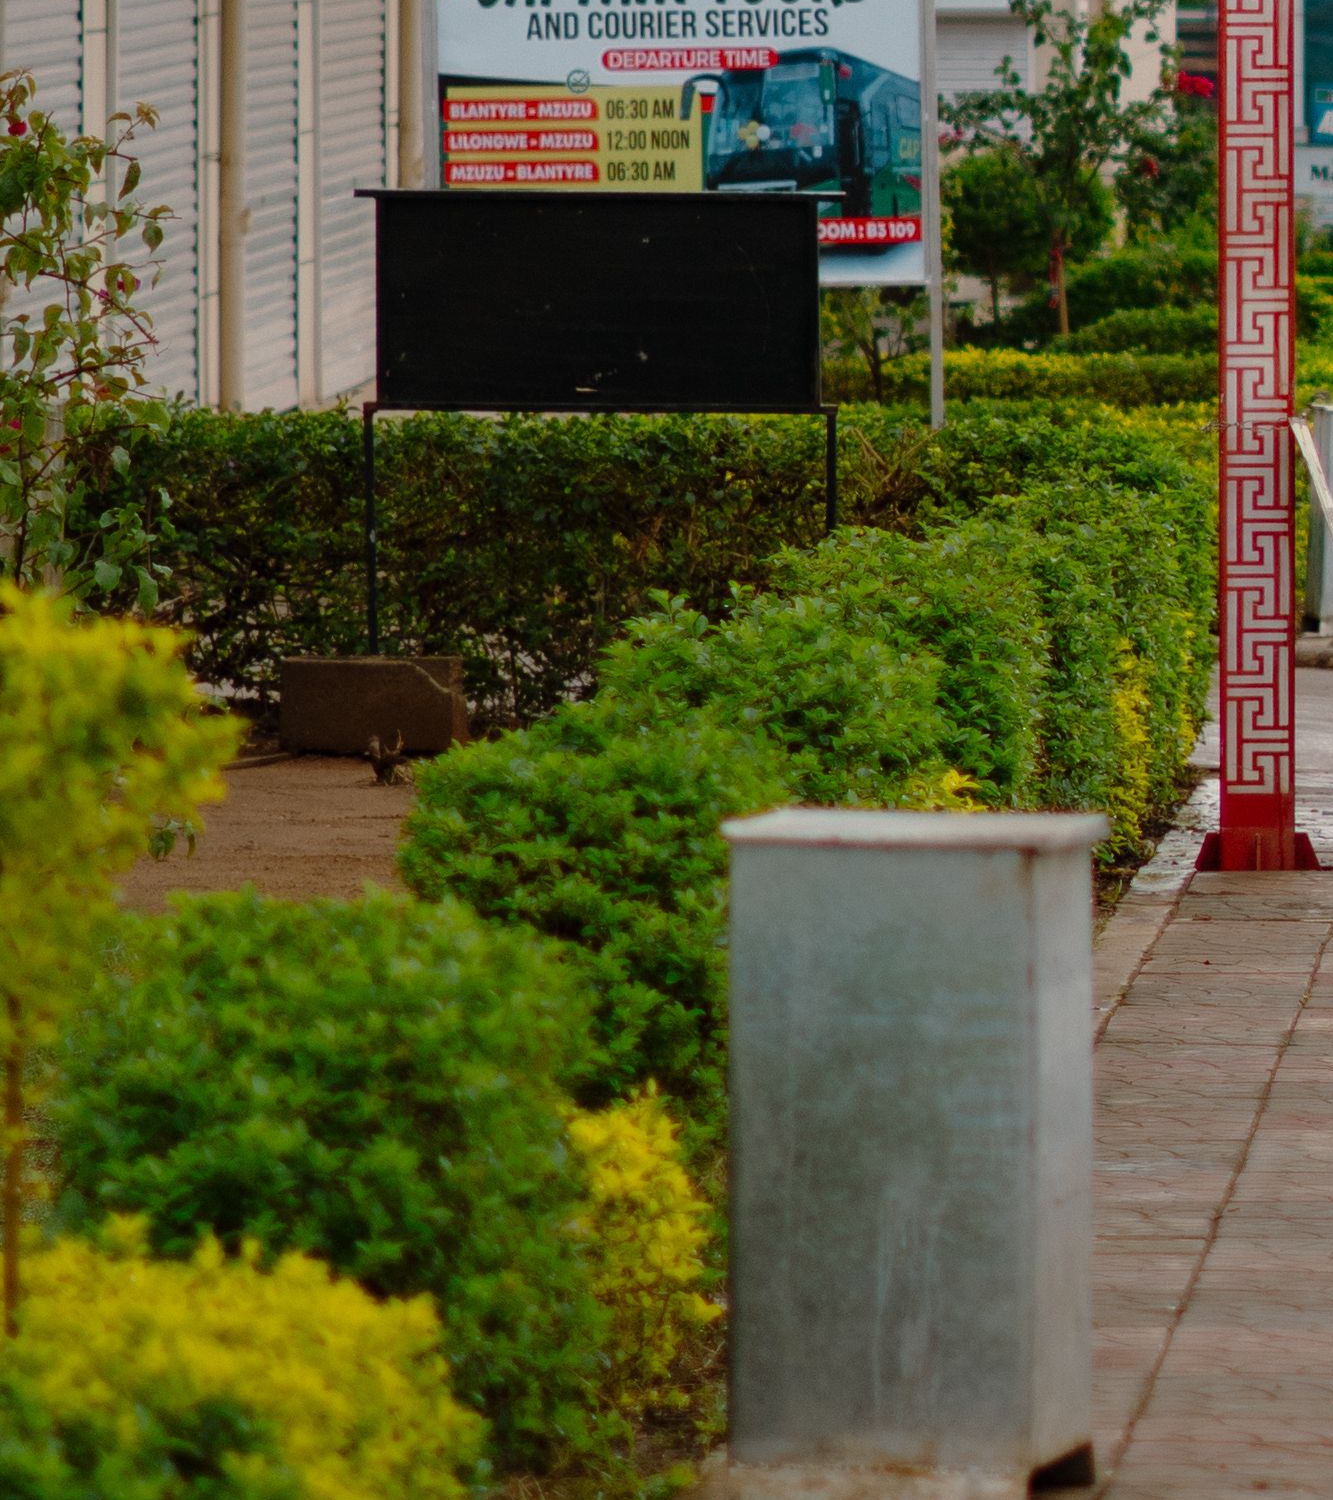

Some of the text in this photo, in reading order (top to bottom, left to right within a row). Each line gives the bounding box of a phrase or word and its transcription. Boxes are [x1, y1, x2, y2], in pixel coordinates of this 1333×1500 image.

[527, 8, 829, 40] AND COURIER SERVICES
[609, 50, 771, 68] DEPARTURE TIME
[450, 102, 526, 118] BLANTYRE
[538, 101, 592, 117] MZUZU
[606, 99, 675, 120] 06:30 AM
[450, 134, 528, 149] LILONGWE
[540, 133, 593, 148] MZUZU
[607, 130, 690, 150] 12:00 NOON
[452, 165, 505, 181] MZUZU
[516, 164, 593, 180] BLANTYRE
[607, 161, 676, 182] 06:30 AM
[889, 221, 916, 237] 109
